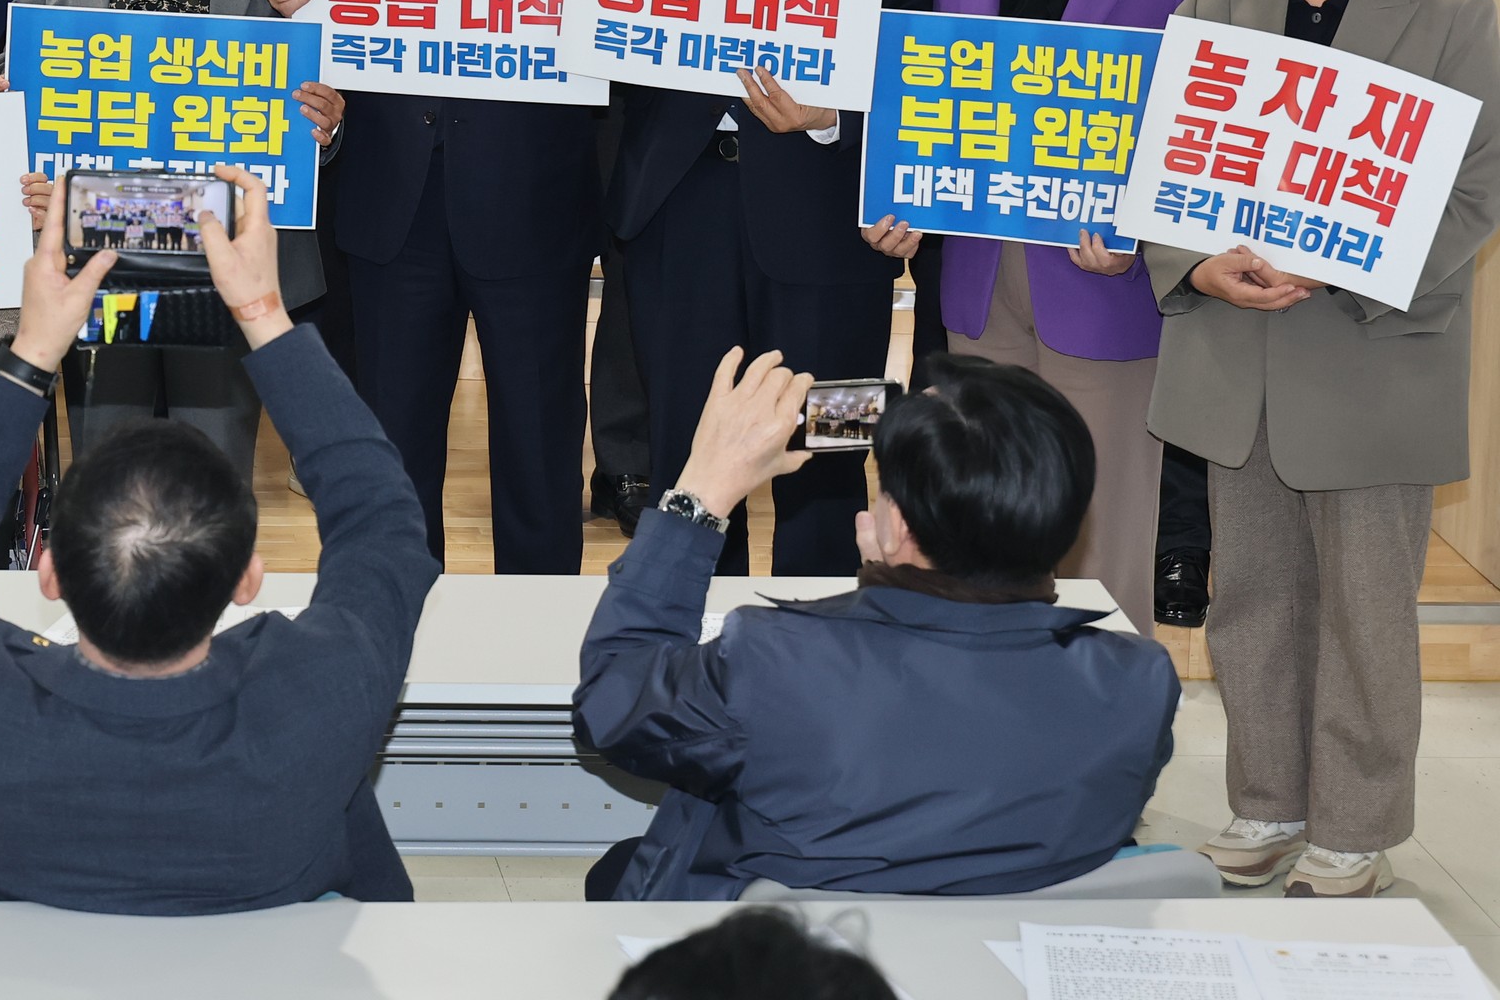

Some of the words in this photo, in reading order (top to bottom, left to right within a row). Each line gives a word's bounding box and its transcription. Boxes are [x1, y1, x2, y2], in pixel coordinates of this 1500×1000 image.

[41, 30, 132, 81] 농업
[149, 37, 288, 89] 생산비
[331, 33, 407, 73] 즉각
[594, 19, 668, 65] 즉각
[678, 32, 836, 86] 마련하라
[901, 36, 994, 91] 농업
[1011, 45, 1143, 104] 생산비
[39, 87, 155, 148] 부담
[172, 95, 289, 155] 완화
[898, 96, 1016, 162] 부담
[1032, 107, 1135, 175] 완화
[893, 164, 975, 211] 대책
[1164, 114, 1270, 188] 공급
[1277, 140, 1409, 228] 대책
[1155, 181, 1225, 231] 즉각
[1232, 198, 1383, 273] 마련하라
